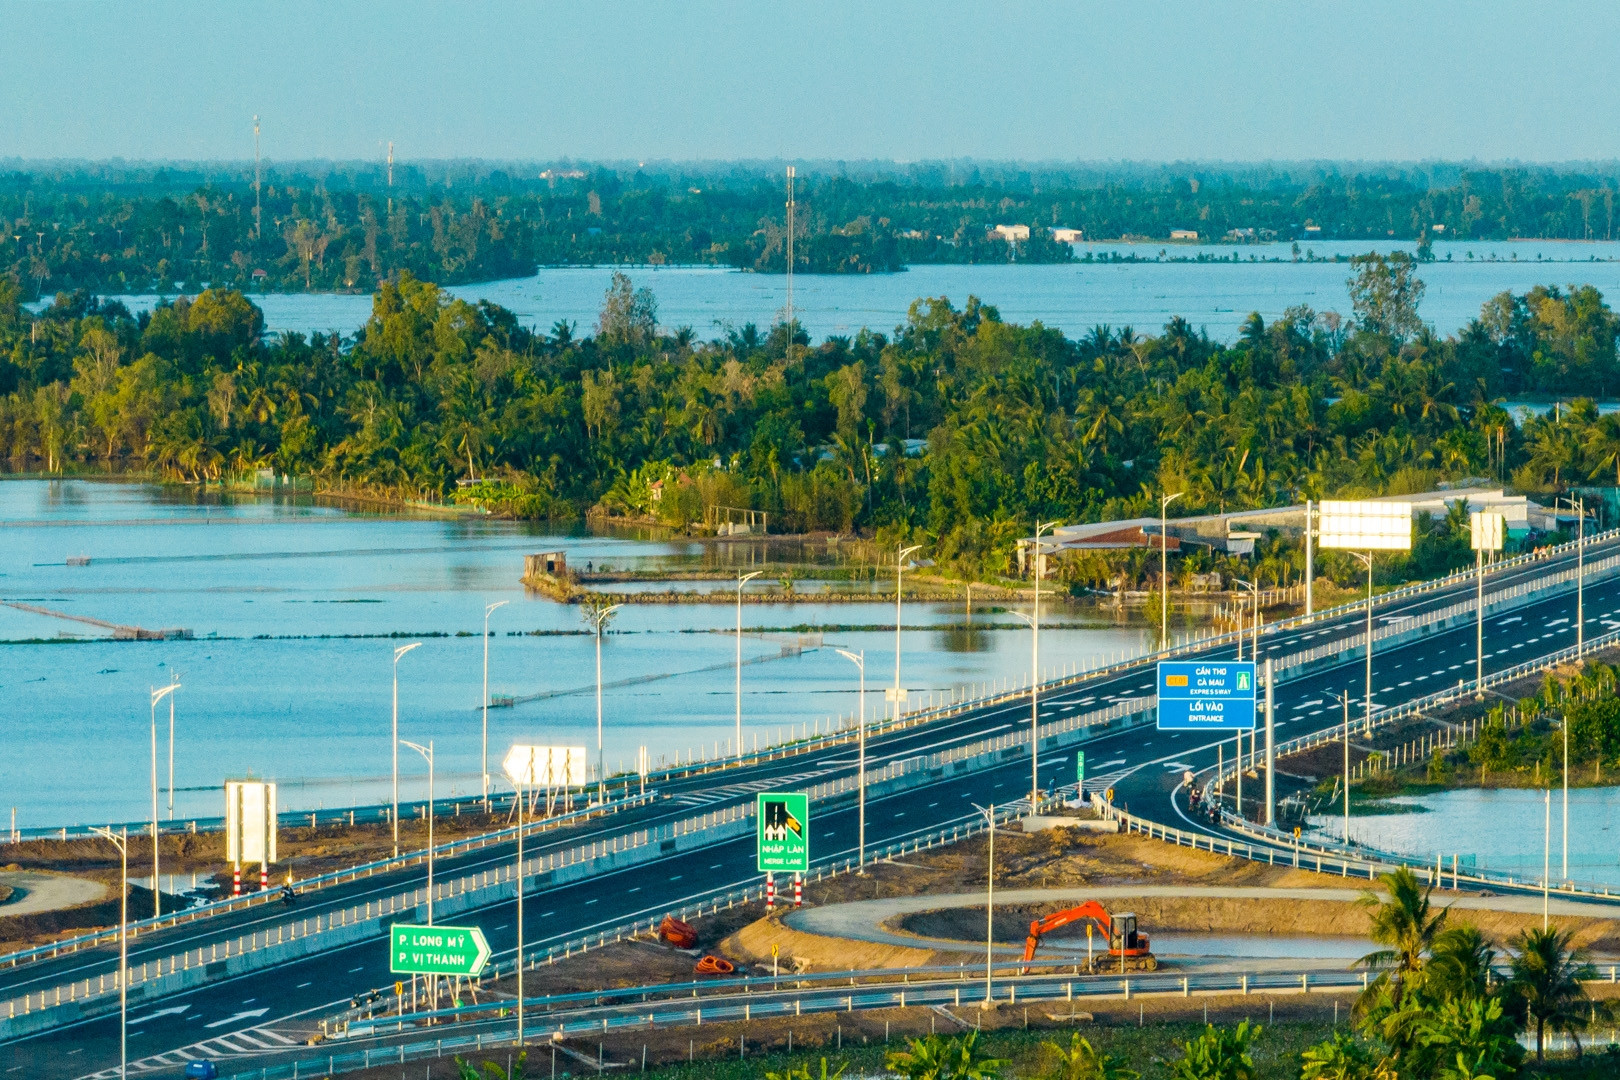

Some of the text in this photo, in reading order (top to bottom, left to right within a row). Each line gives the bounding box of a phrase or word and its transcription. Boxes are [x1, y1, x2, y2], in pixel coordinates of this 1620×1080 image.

[1197, 677, 1225, 687] CÀ MAU
[1189, 700, 1224, 712] LỐI VÀO
[1188, 714, 1224, 722] ENTRANCE
[787, 843, 804, 854] LÀN
[399, 934, 465, 948] P. LONG MỸ
[399, 952, 465, 966] P. VỊ THANH
